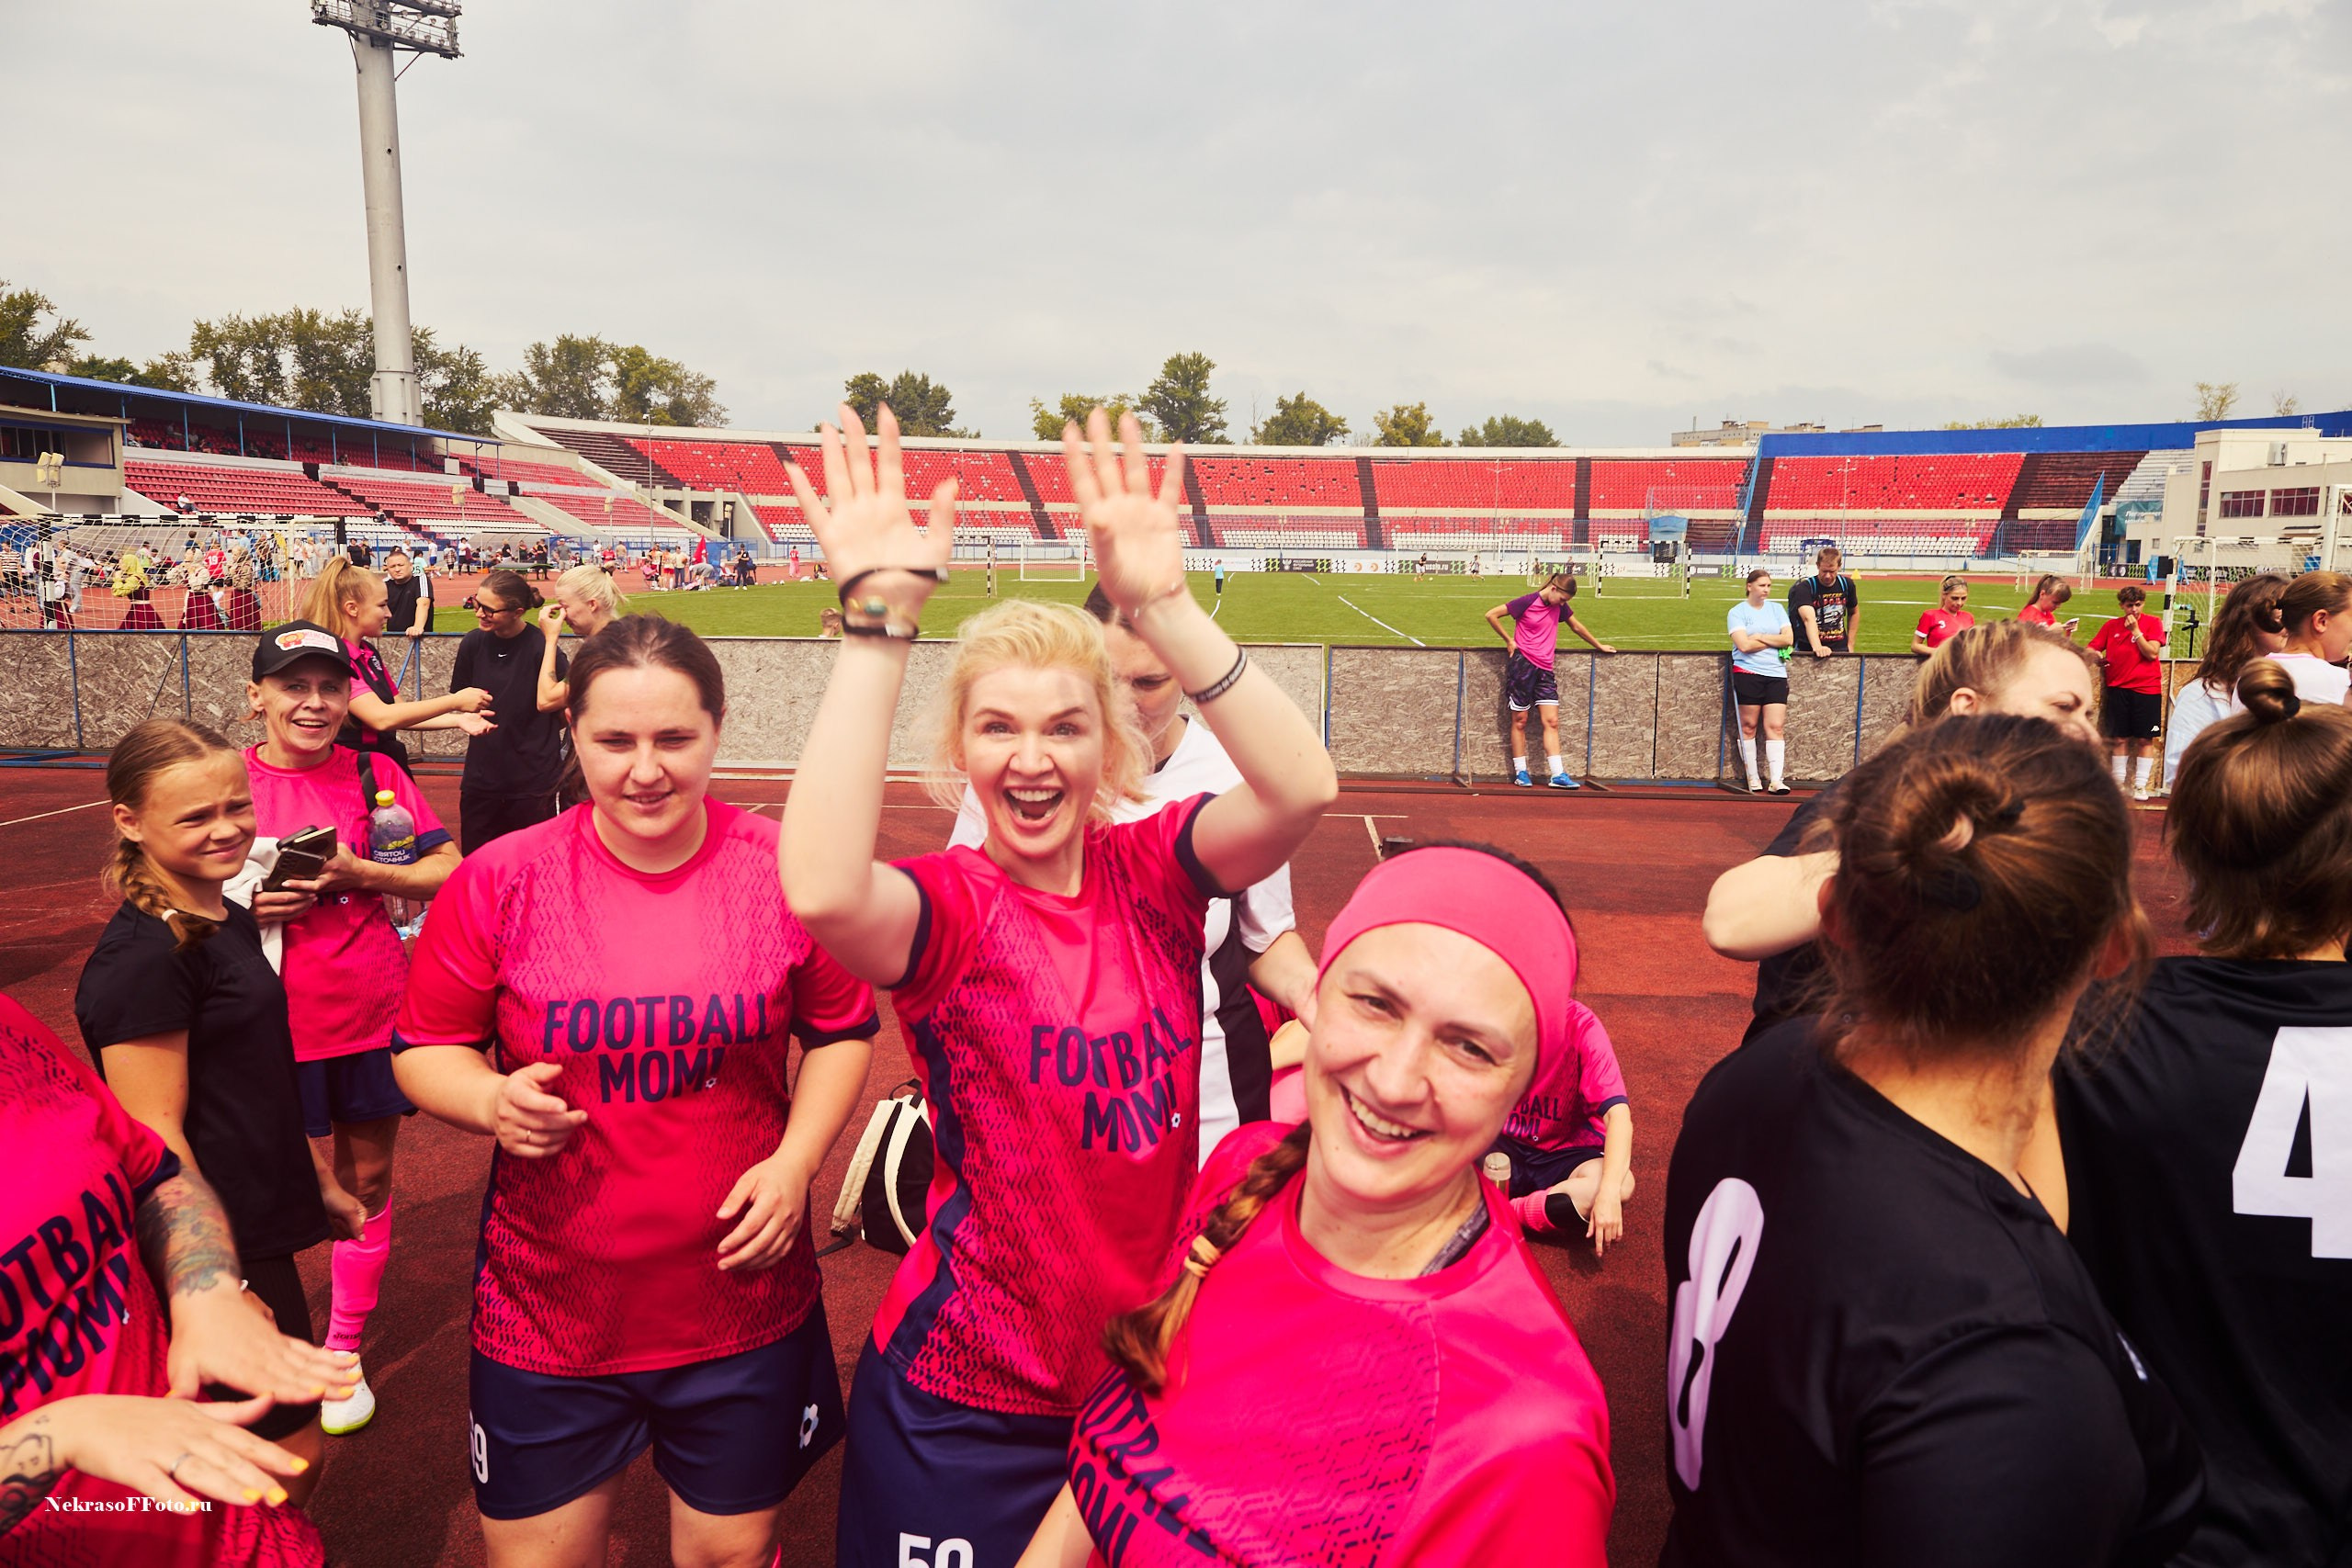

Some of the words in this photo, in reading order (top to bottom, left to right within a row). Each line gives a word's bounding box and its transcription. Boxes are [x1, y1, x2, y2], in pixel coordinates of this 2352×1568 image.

[1939, 620, 1946, 628] 3
[543, 993, 773, 1054] FOOTBALL
[599, 1047, 726, 1104] MOM!
